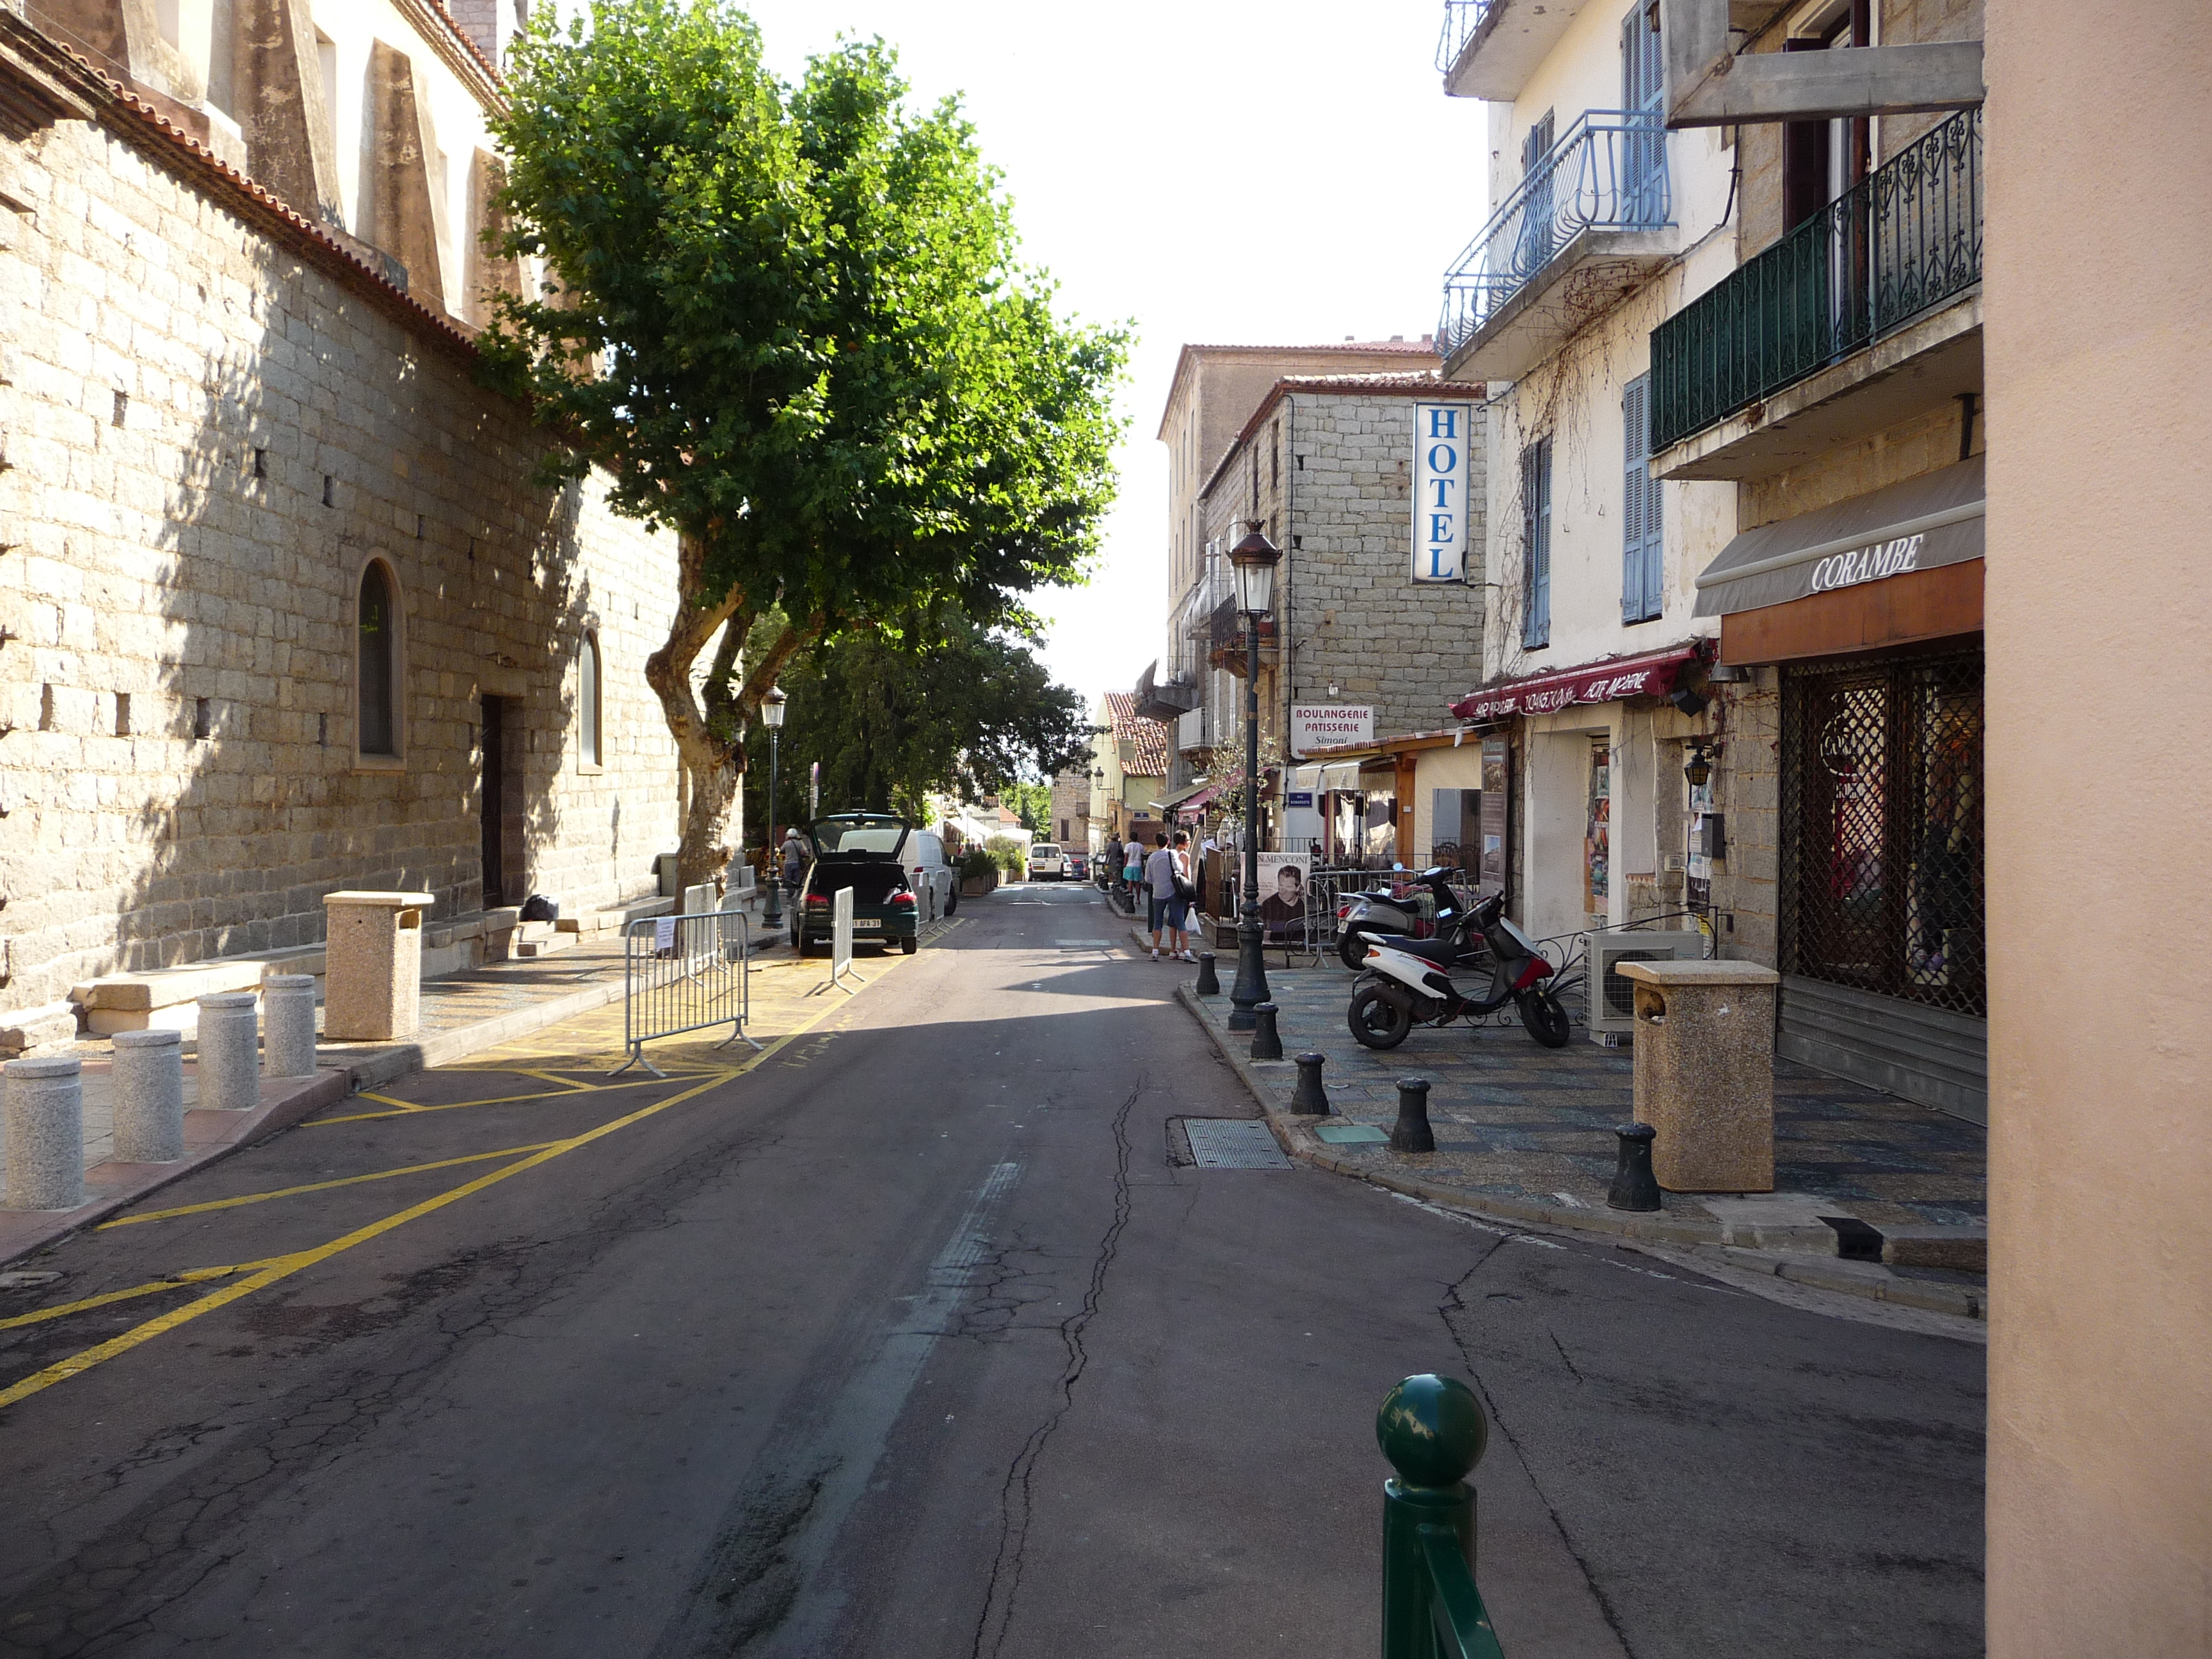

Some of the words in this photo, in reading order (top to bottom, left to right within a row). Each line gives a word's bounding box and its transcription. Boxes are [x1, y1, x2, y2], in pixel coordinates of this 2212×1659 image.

[1427, 408, 1458, 578] HOTEL
[1811, 533, 1924, 591] CORAMBE
[1296, 709, 1368, 719] BOULANGERIE
[1305, 723, 1359, 732] PATISSERIE
[1315, 735, 1348, 744] Simoni
[1266, 855, 1307, 864] MENCONI
